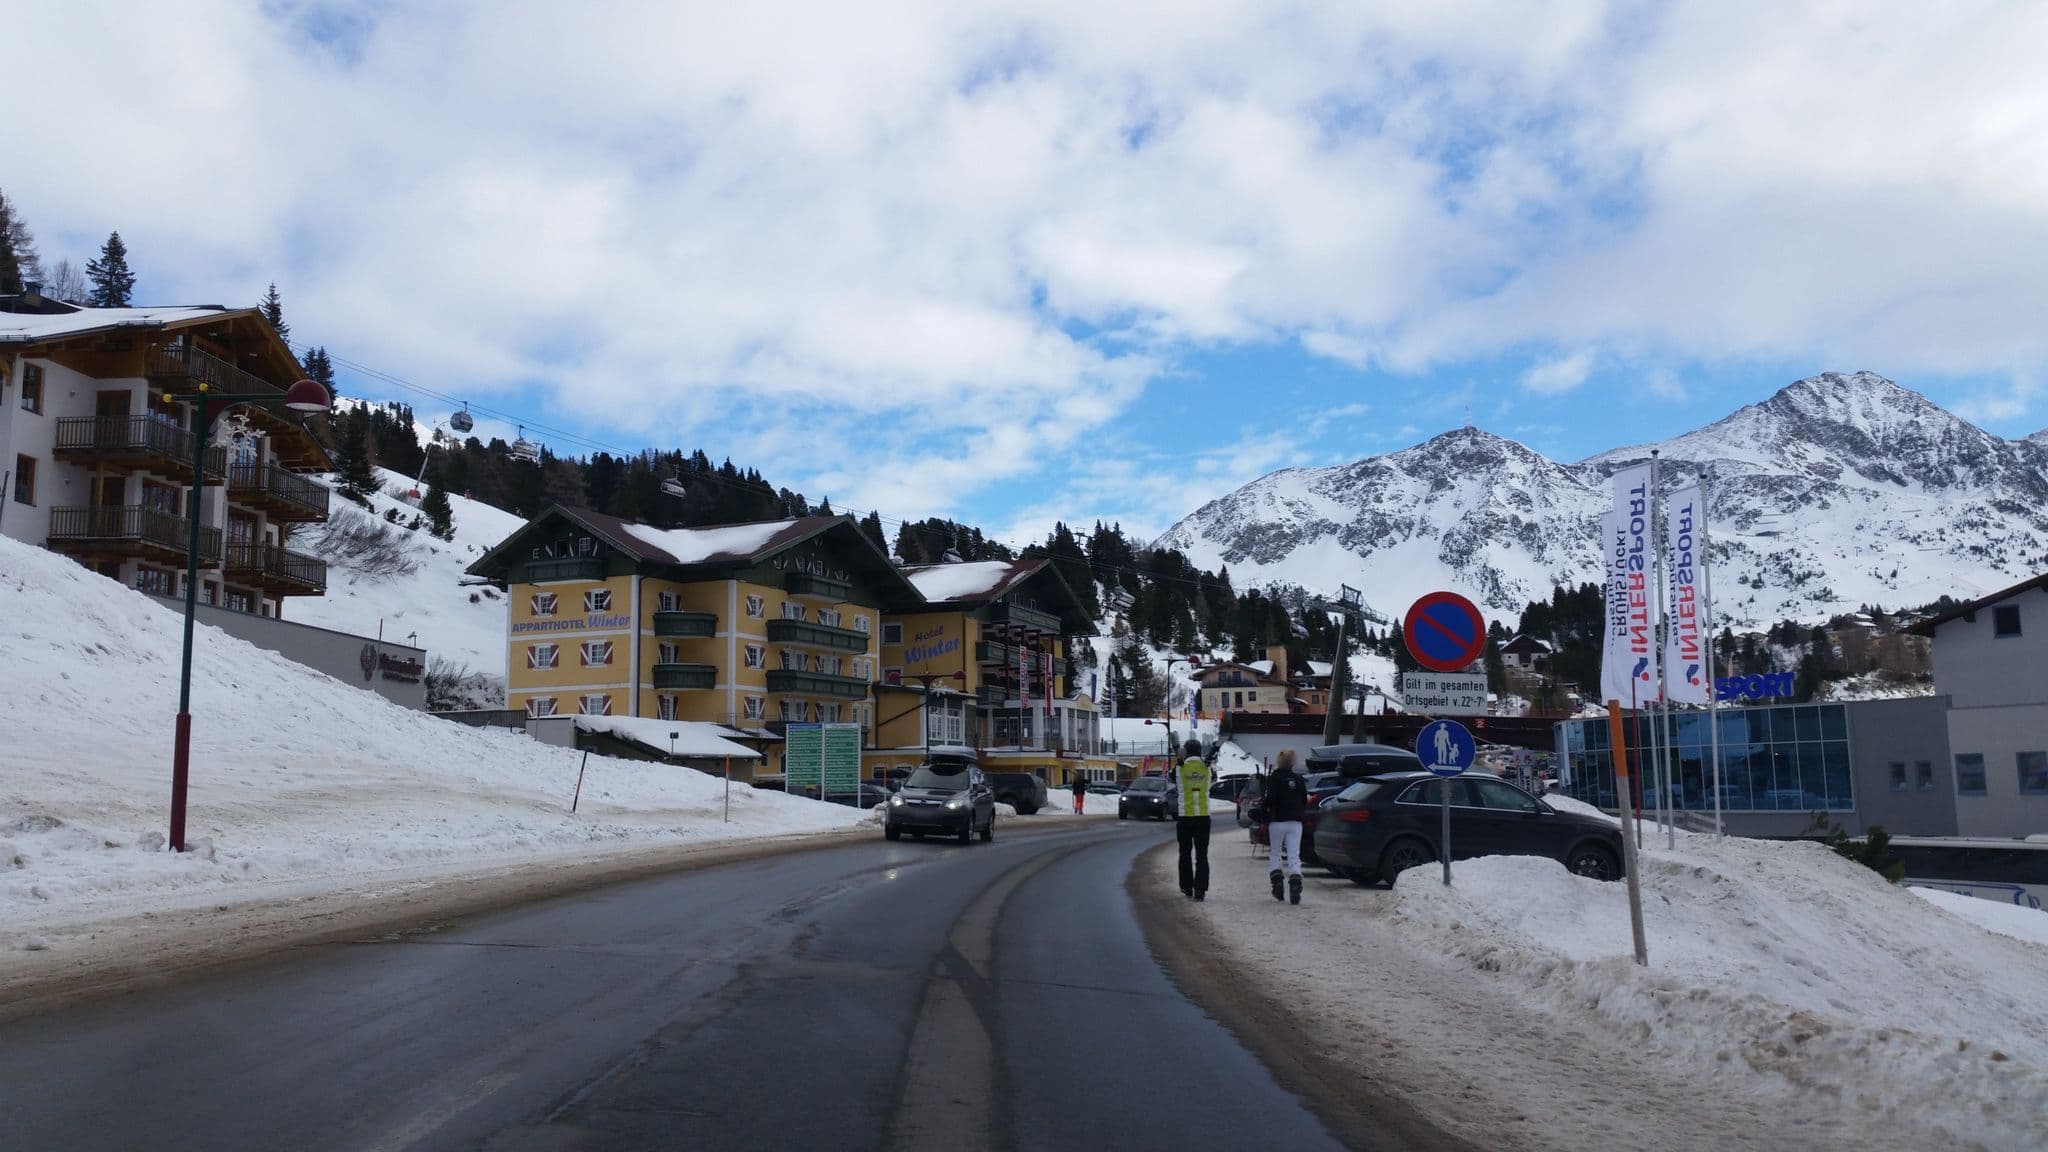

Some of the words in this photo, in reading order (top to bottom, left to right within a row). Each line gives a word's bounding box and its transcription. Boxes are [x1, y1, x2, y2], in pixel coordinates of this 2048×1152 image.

[512, 619, 586, 633] APPARTHOTEL
[588, 614, 631, 628] Winter
[914, 625, 945, 642] Hotel
[904, 638, 960, 664] Winter
[1405, 678, 1421, 689] Gilt
[1425, 678, 1437, 690] im
[1440, 680, 1485, 693] gesamten
[1405, 694, 1449, 708] Ortsgebiet
